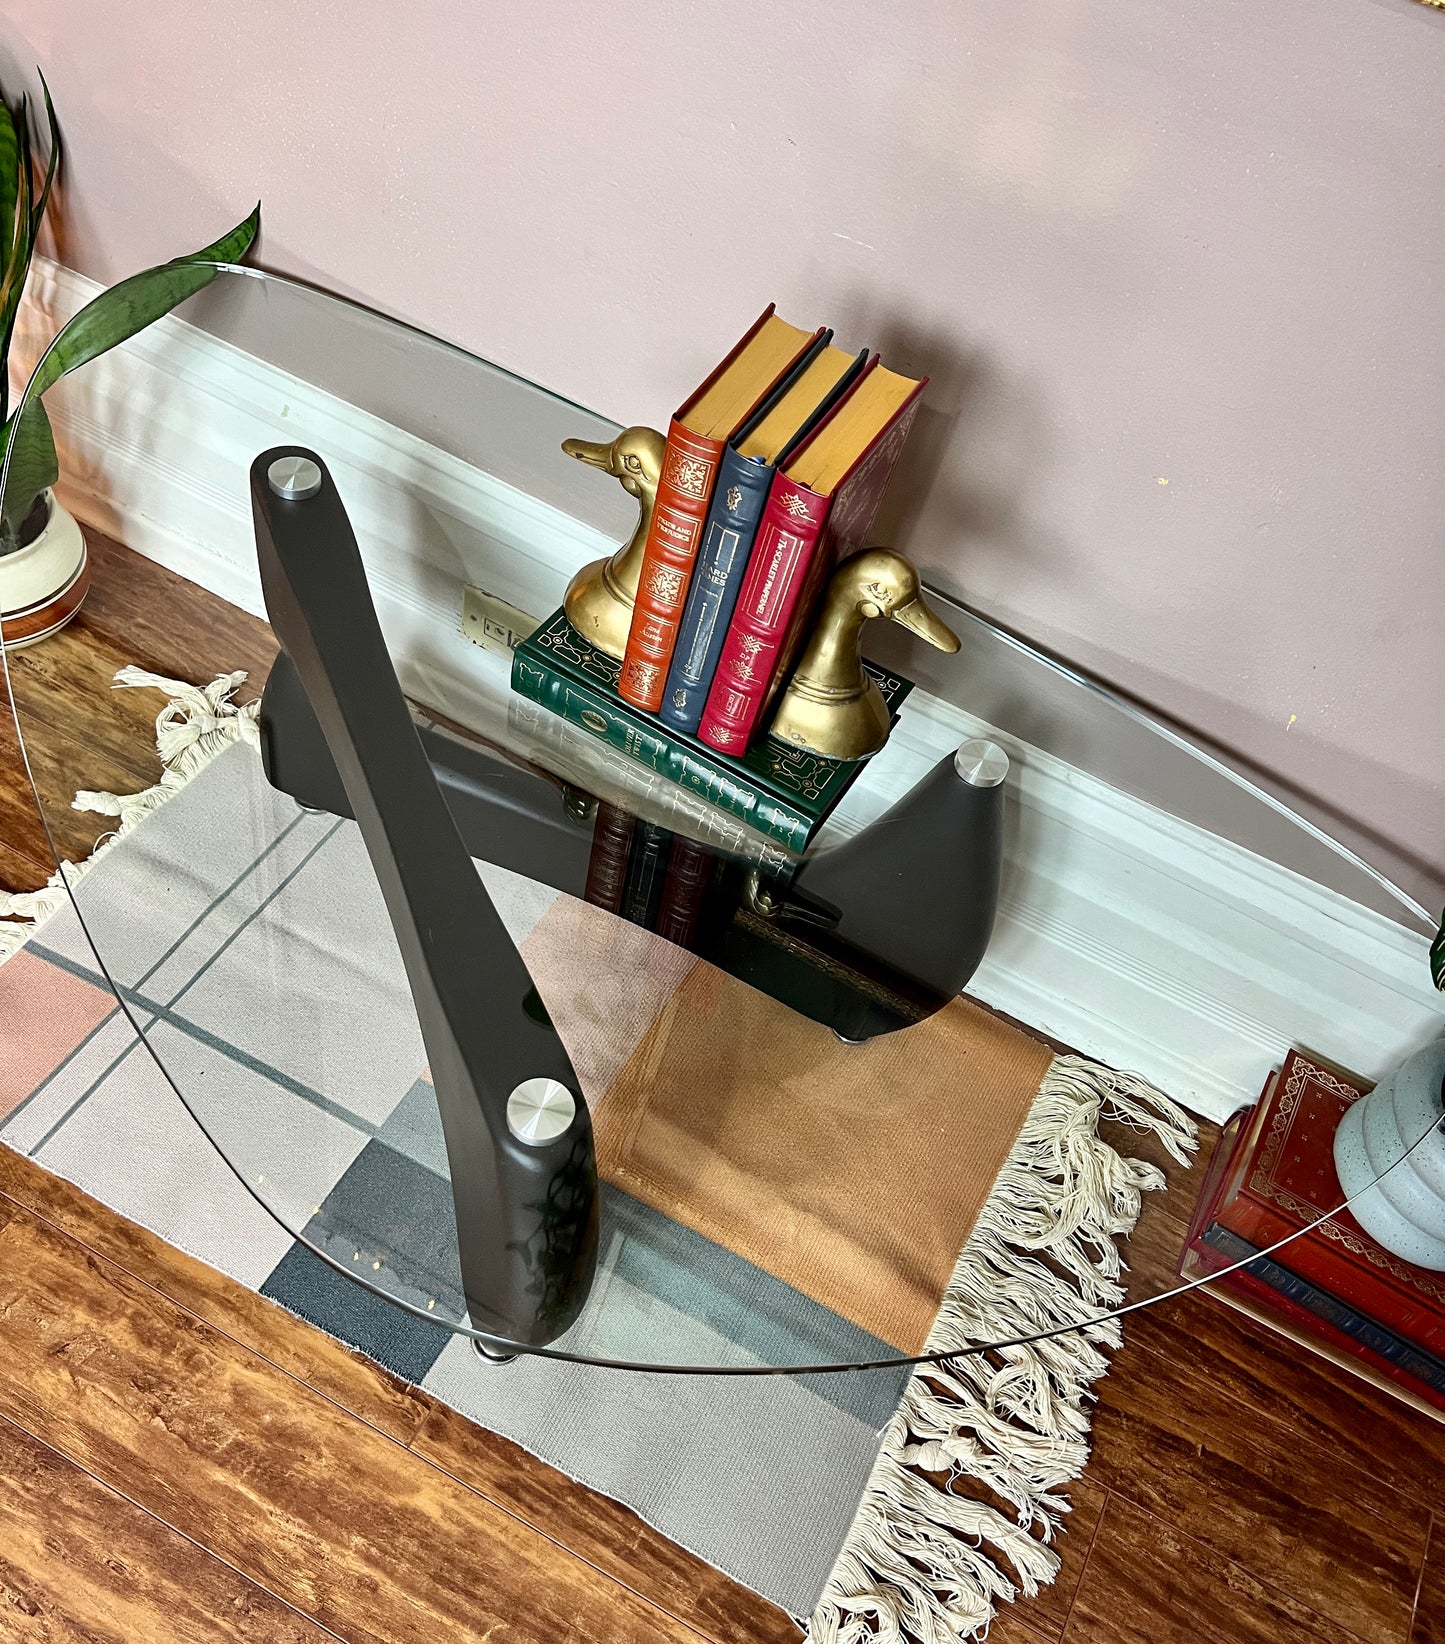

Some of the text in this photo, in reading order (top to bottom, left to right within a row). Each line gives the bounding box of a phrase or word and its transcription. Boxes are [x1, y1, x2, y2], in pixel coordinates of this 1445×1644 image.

[676, 526, 692, 536] AND
[776, 538, 788, 549] The
[768, 549, 783, 580] SCARLET
[633, 734, 643, 756] TWIST
